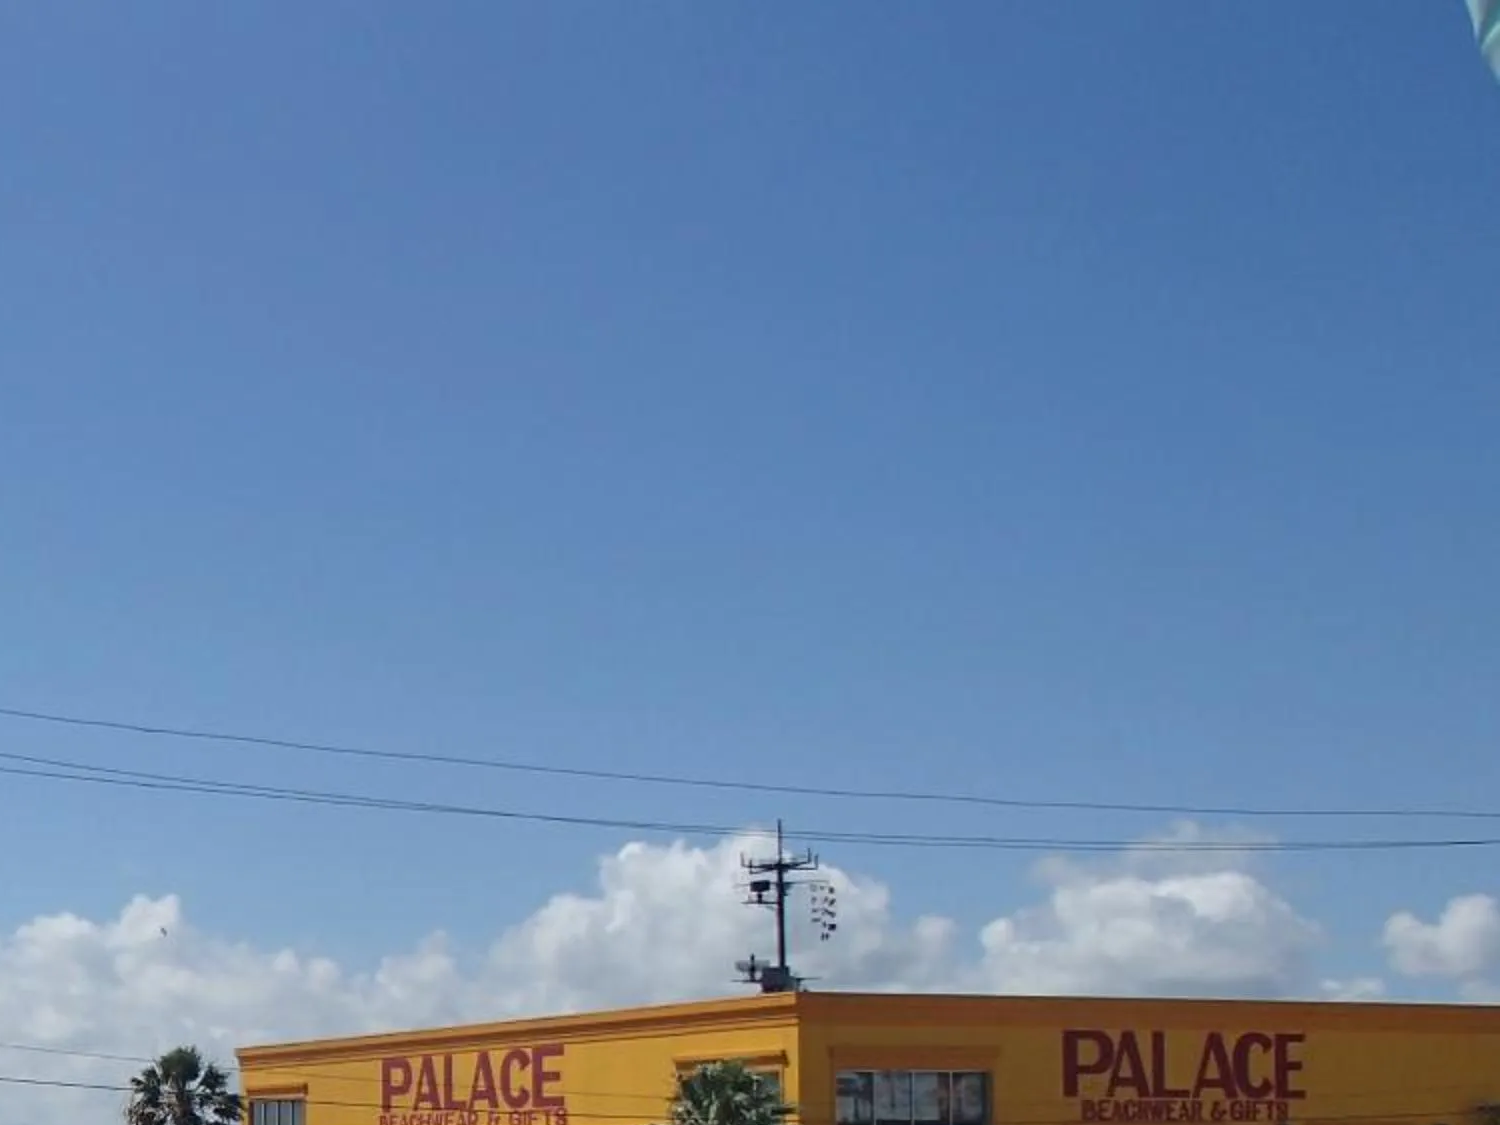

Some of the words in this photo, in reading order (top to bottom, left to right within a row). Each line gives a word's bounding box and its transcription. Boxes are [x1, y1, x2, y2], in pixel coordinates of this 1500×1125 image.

[382, 1044, 565, 1112] PALACE
[1062, 1030, 1306, 1099] PALACE
[1081, 1099, 1203, 1121] BEACHWEAR
[1211, 1101, 1227, 1121] &
[1230, 1101, 1289, 1121] GIFTS
